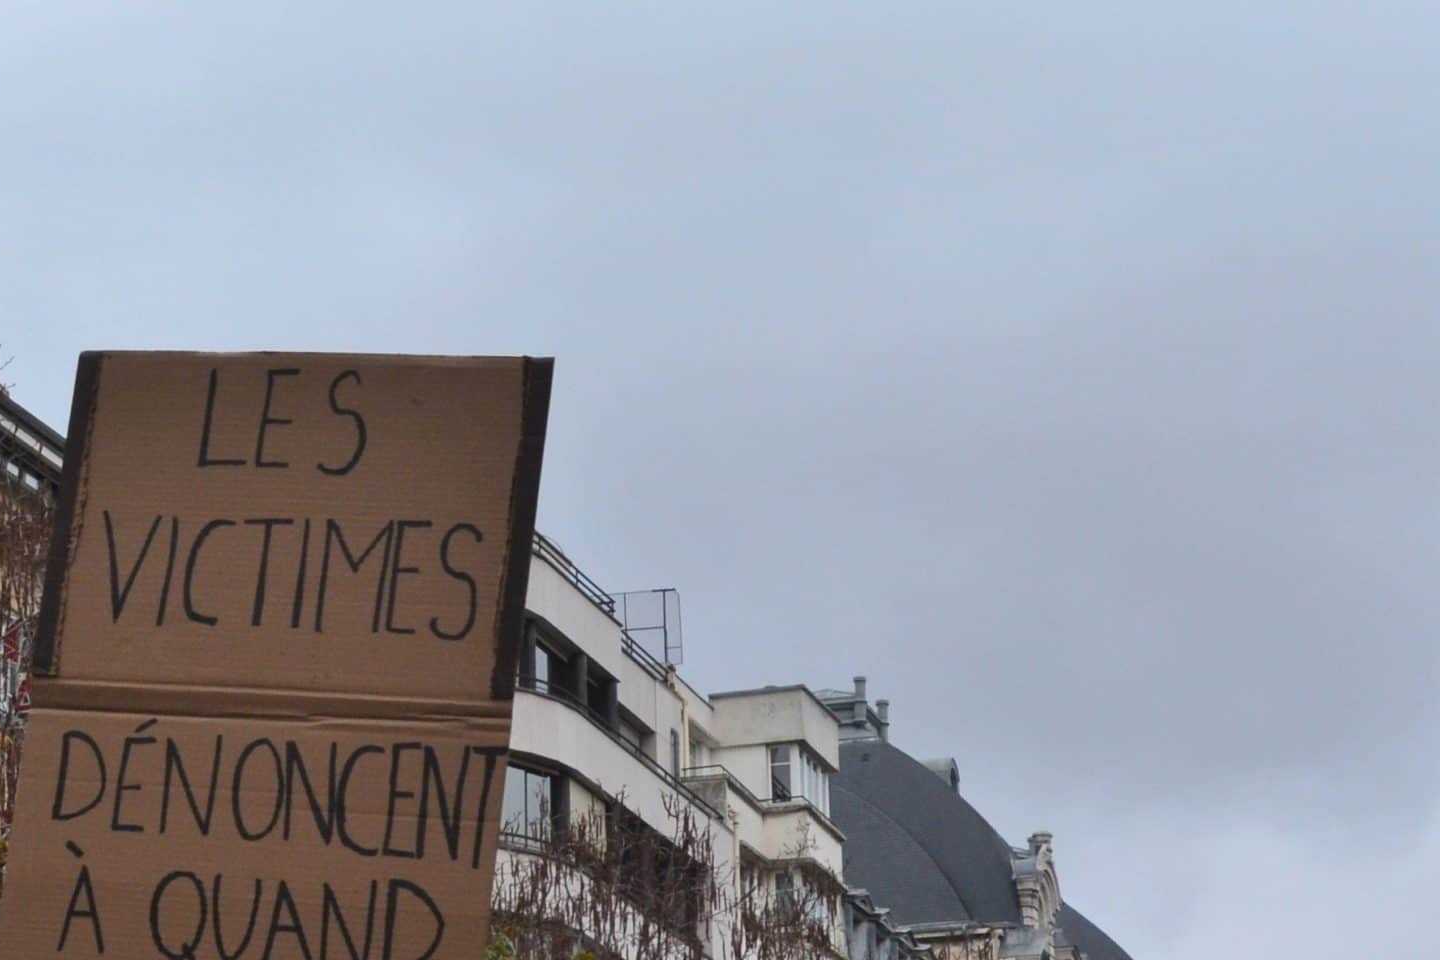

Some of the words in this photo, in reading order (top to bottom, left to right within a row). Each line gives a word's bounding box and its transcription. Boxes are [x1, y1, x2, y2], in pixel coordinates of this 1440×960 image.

[197, 367, 367, 476] LES
[102, 509, 484, 641] VICTIMES
[50, 718, 510, 869] DÉNONCENT
[57, 840, 105, 954] À
